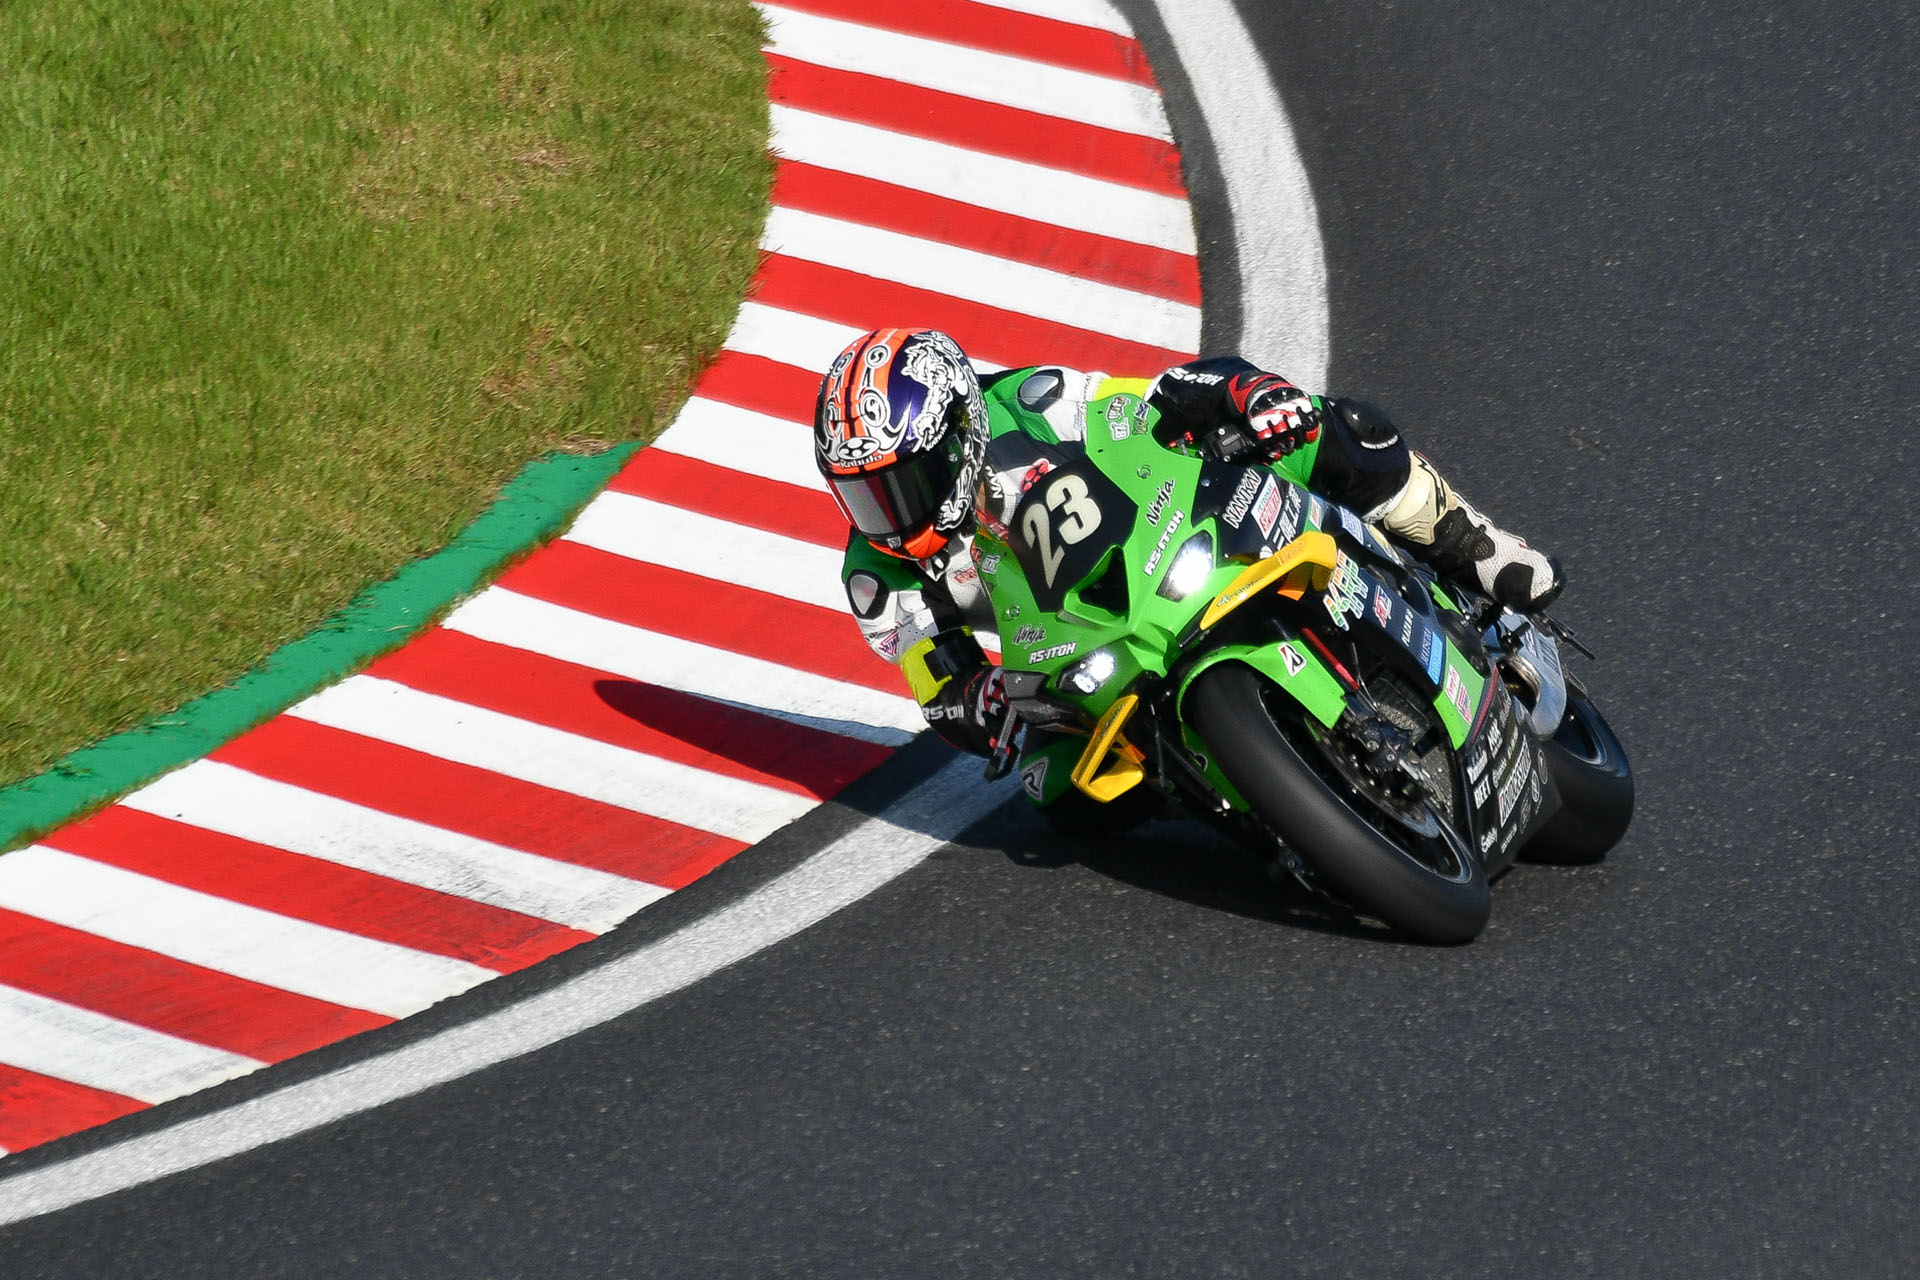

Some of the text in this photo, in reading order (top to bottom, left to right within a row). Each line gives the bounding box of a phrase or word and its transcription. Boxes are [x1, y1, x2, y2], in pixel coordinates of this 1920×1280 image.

[1145, 477, 1176, 528] Ninja
[1222, 467, 1262, 530] NANKAI
[1022, 474, 1103, 590] 23
[1322, 548, 1369, 632] KRP
[1013, 622, 1047, 649] Ninja
[1473, 774, 1492, 810] BEET
